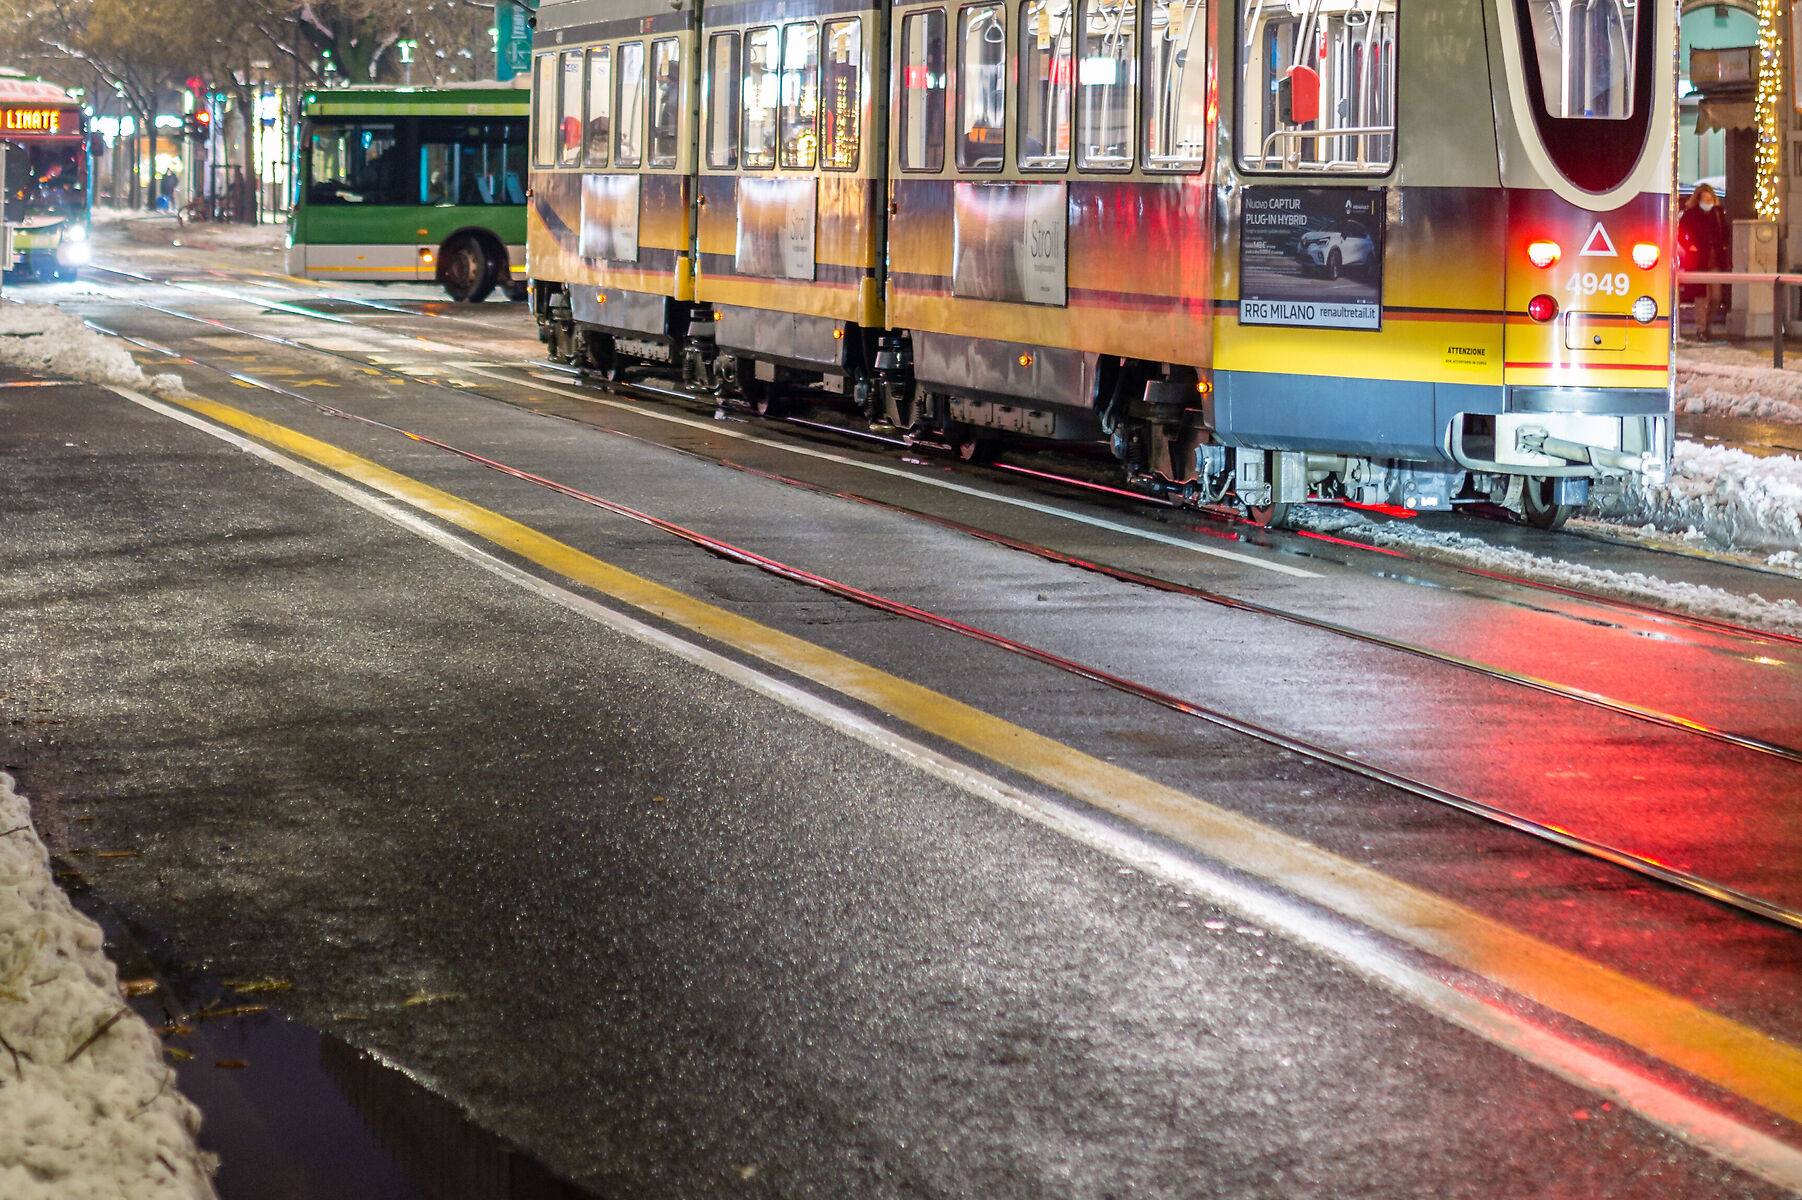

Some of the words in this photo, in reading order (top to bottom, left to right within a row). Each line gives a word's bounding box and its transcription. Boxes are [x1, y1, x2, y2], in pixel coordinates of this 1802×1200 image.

[1245, 199, 1268, 209] Nuovo
[1269, 198, 1301, 210] CAPTUR
[1245, 214, 1277, 225] PLUG-IN
[1278, 215, 1307, 226] HYBRID
[1565, 271, 1630, 297] 4949
[1245, 303, 1268, 319] RRG
[1270, 304, 1315, 320] MILANO
[1320, 306, 1376, 319] renaultretail.it
[1447, 346, 1486, 356] ATTENZIONE
